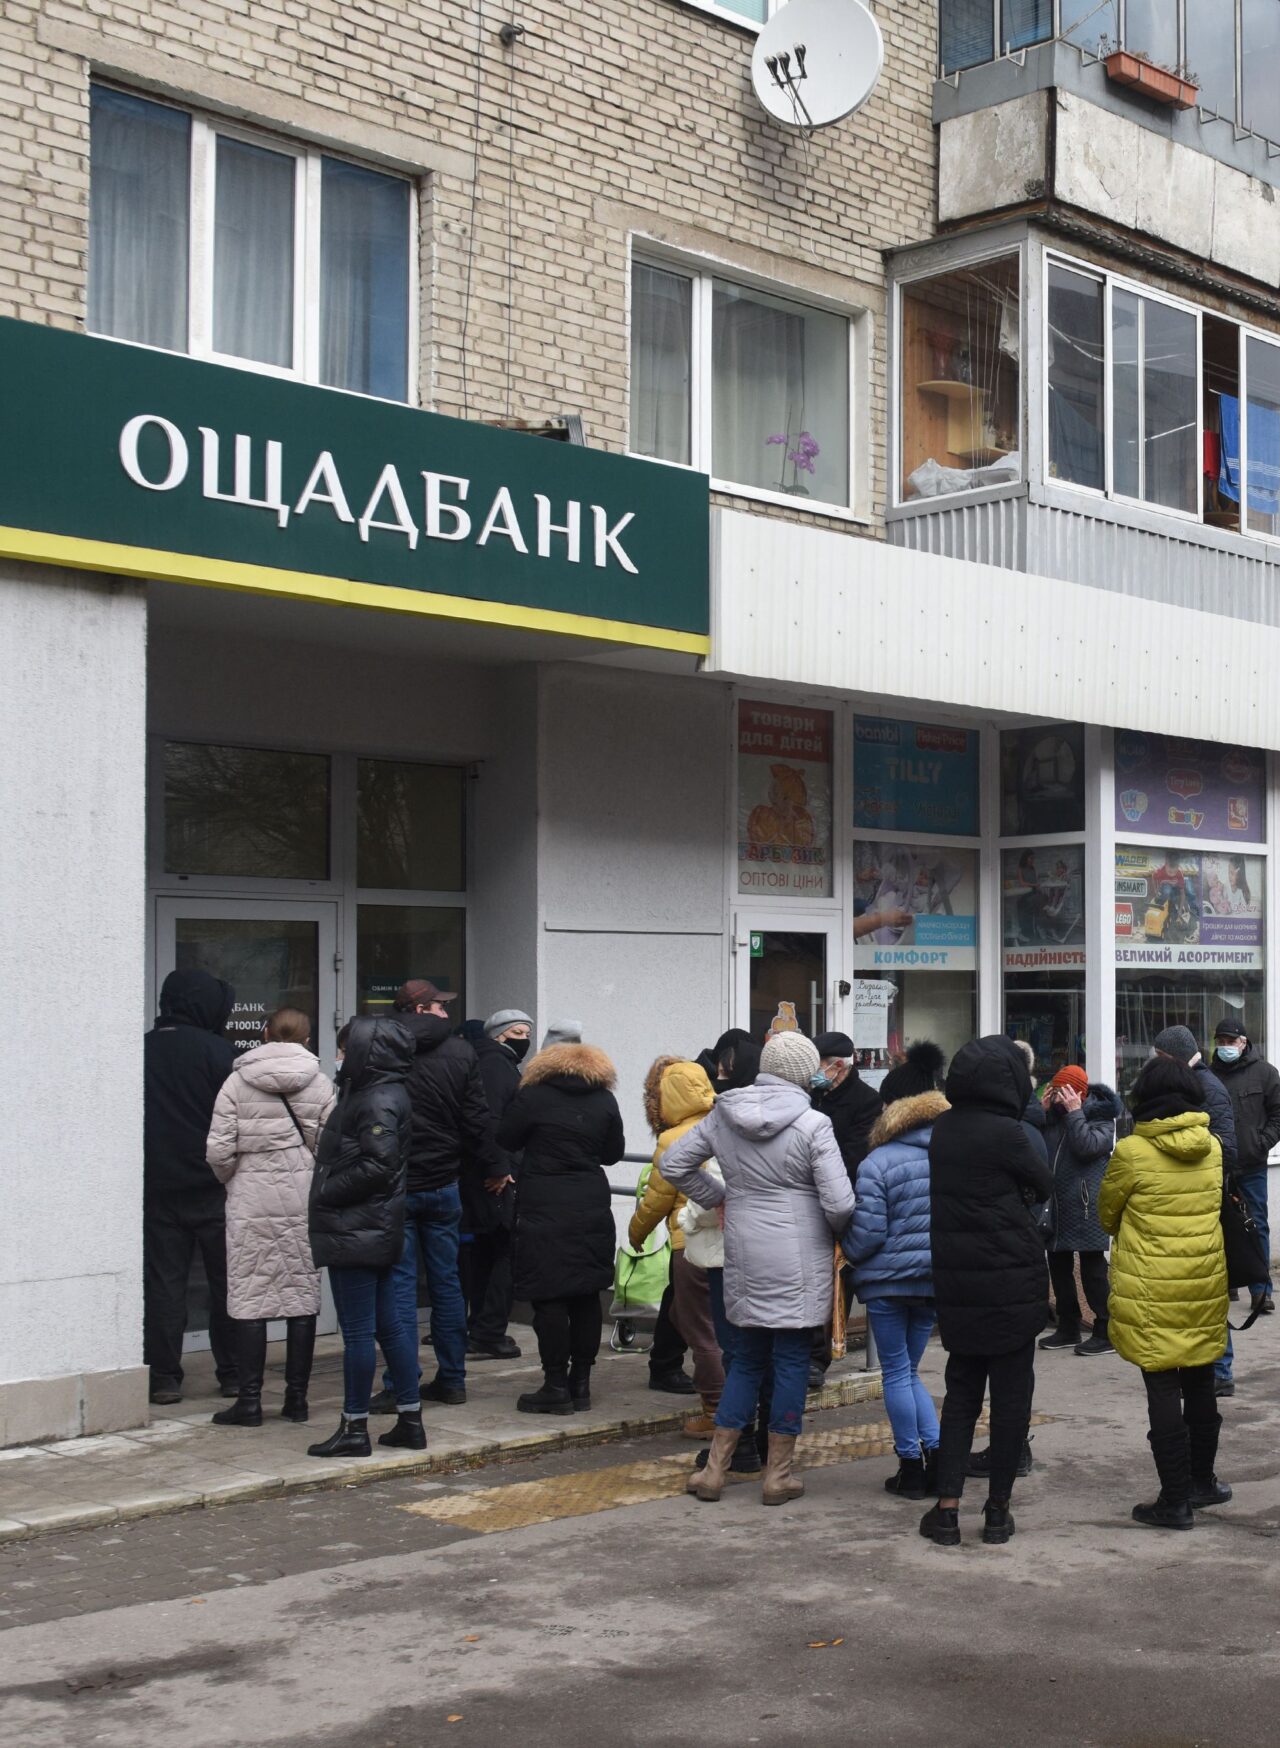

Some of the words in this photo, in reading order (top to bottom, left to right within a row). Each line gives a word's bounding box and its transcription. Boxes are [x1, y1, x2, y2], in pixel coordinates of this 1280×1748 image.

[119, 413, 639, 574] ОЩАДБАНК
[752, 711, 814, 732] товари
[740, 731, 774, 746] для
[780, 732, 823, 753] дітей
[741, 871, 789, 887] ОПТОВІ
[793, 874, 823, 890] ЦІНИ
[1115, 881, 1145, 893] INSMART
[1116, 913, 1132, 925] LEGO
[874, 950, 949, 965] КОМФОРТ
[1006, 948, 1086, 968] НАДІЙНІСТЬ
[1115, 946, 1172, 963] ВЕЛИКИЙ
[1177, 951, 1255, 964] АСОРТИМЕНТ
